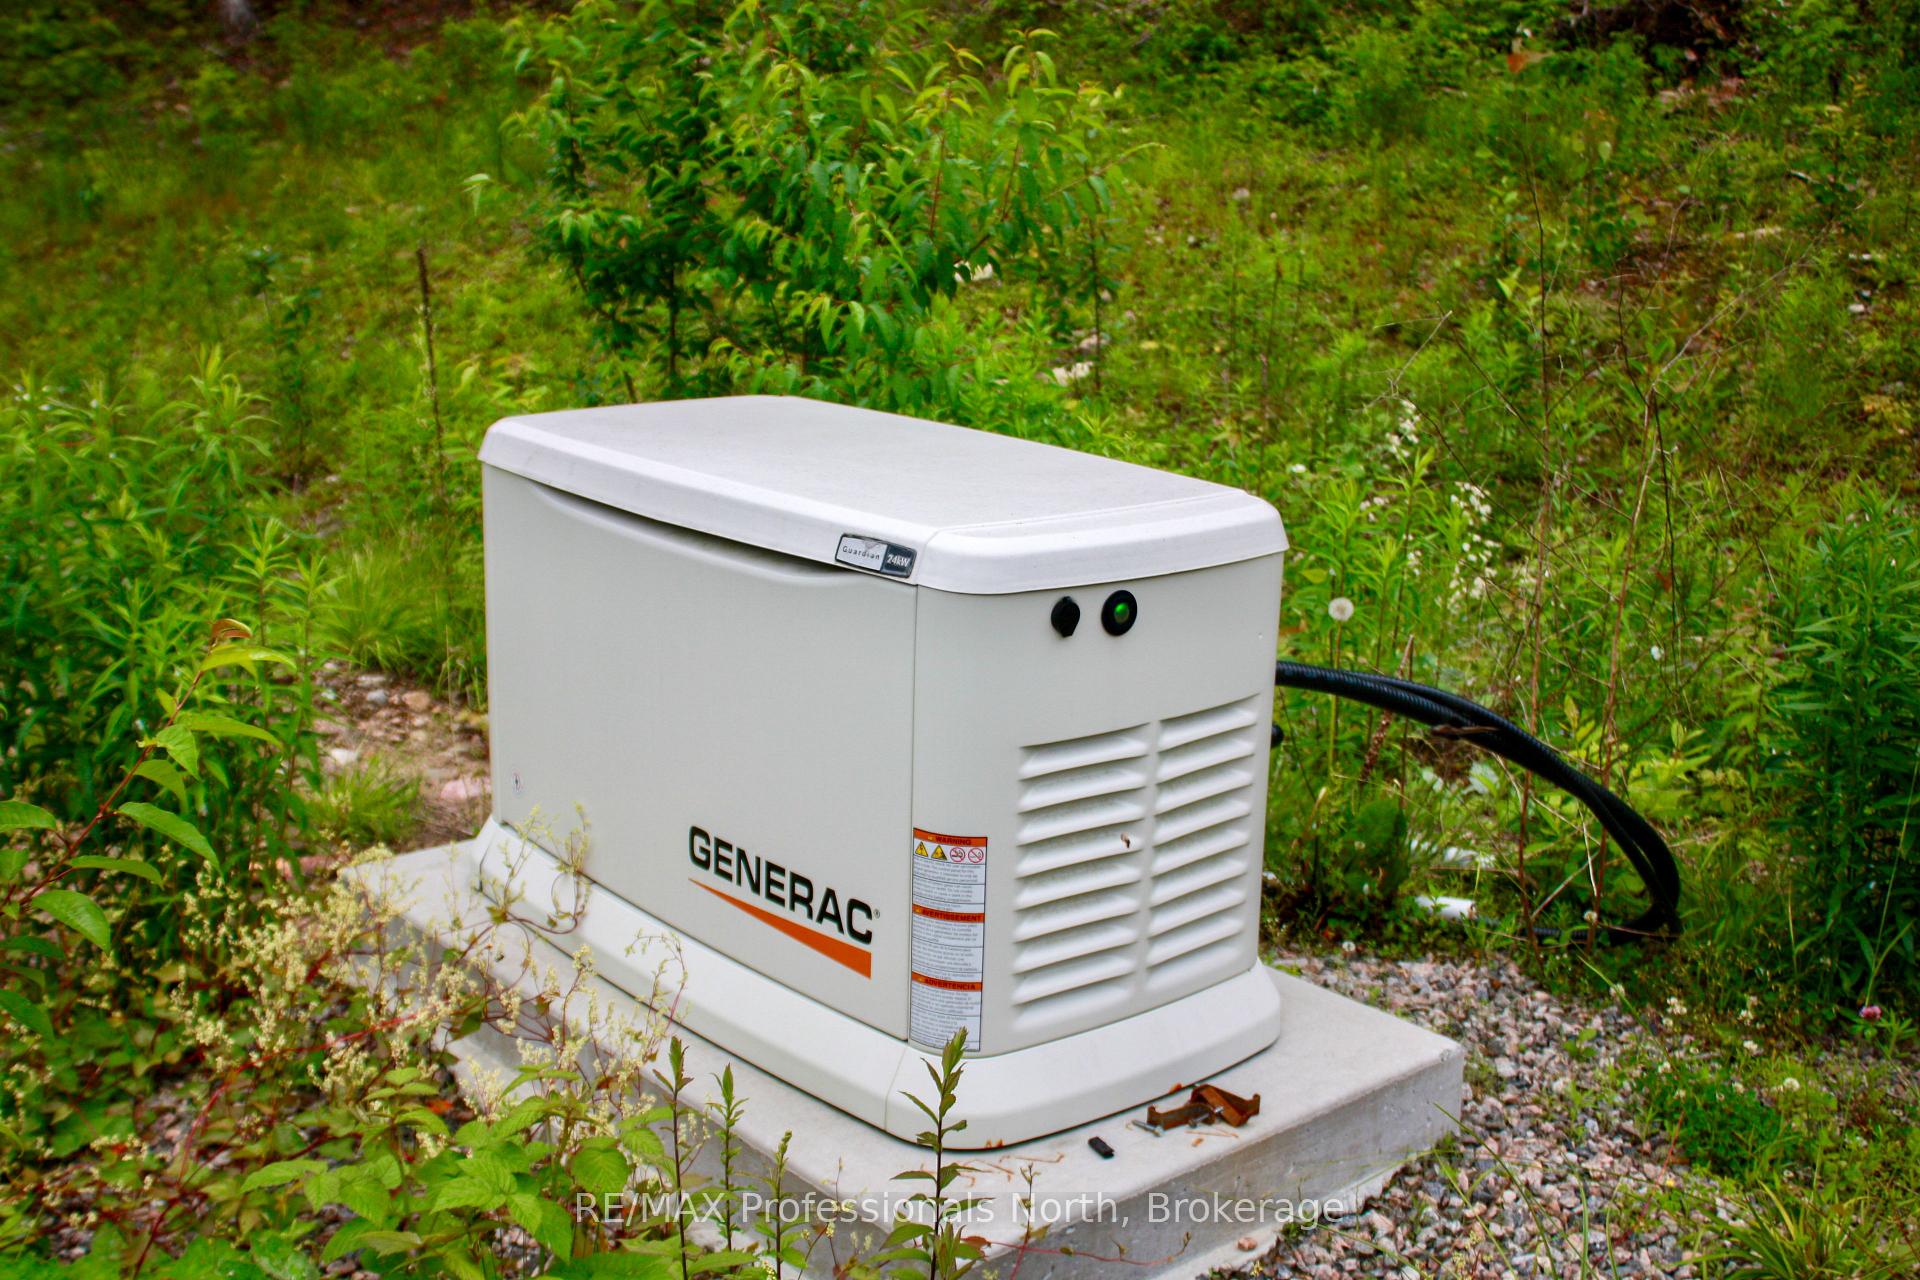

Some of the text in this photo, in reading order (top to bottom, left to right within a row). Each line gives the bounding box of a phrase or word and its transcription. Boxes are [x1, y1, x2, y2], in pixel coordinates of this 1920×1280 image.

[842, 545, 911, 568] Guardian 24kW
[935, 835, 972, 846] WARNING
[688, 825, 873, 945] GENERAC
